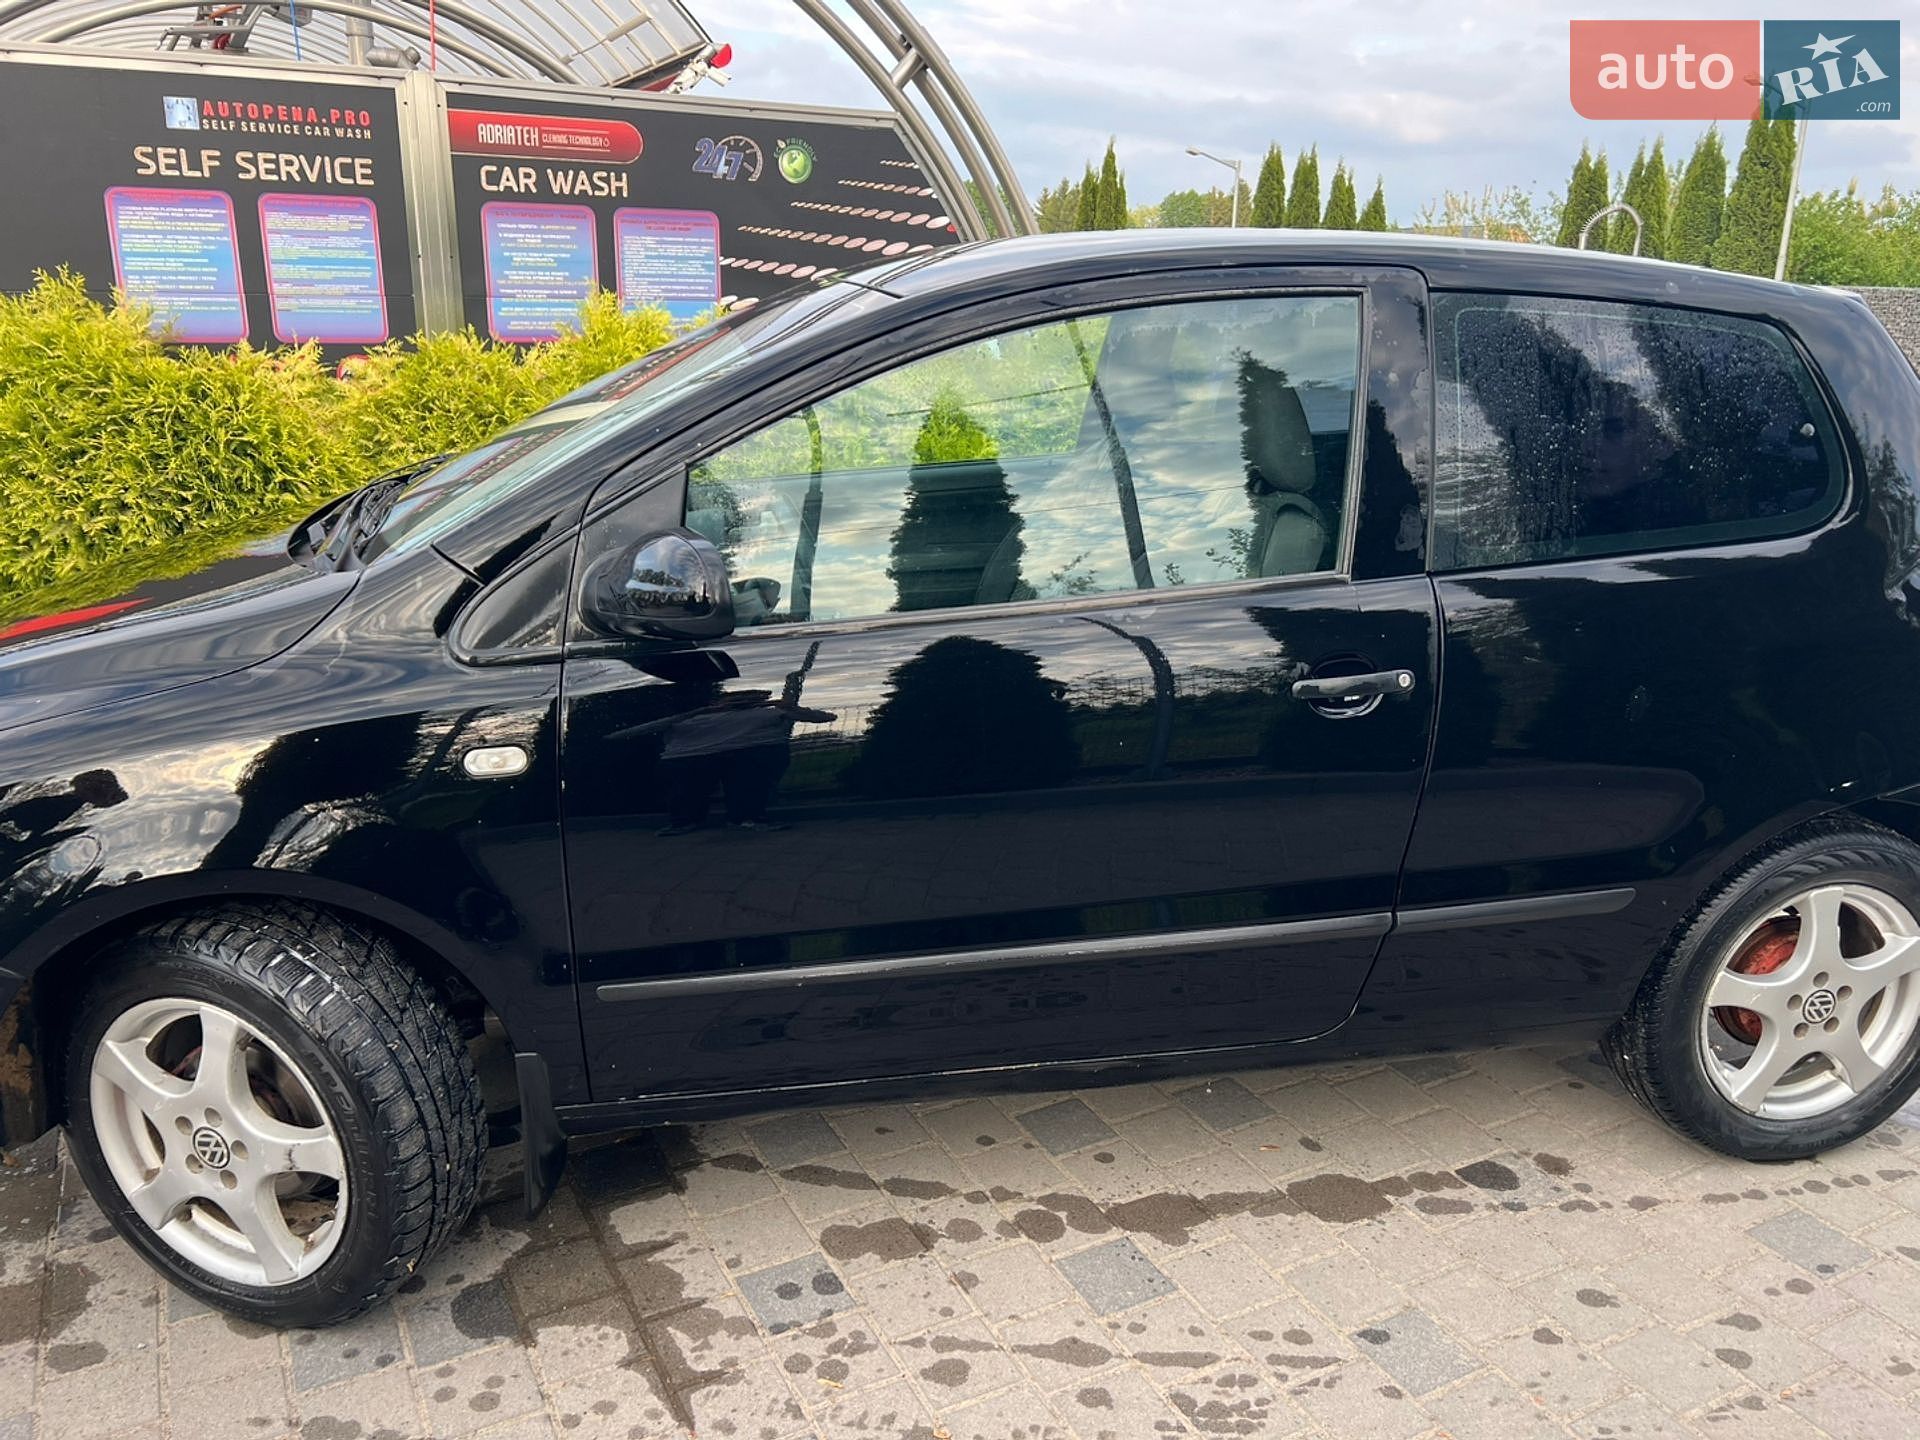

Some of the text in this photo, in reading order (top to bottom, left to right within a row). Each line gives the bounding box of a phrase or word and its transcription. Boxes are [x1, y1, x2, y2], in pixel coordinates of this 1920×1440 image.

[202, 118, 371, 140] SELF SERVICE CAR WASH
[477, 123, 540, 147] ADRIATEH
[133, 146, 375, 186] SELF SERVICE
[479, 164, 629, 198] CAR WASH
